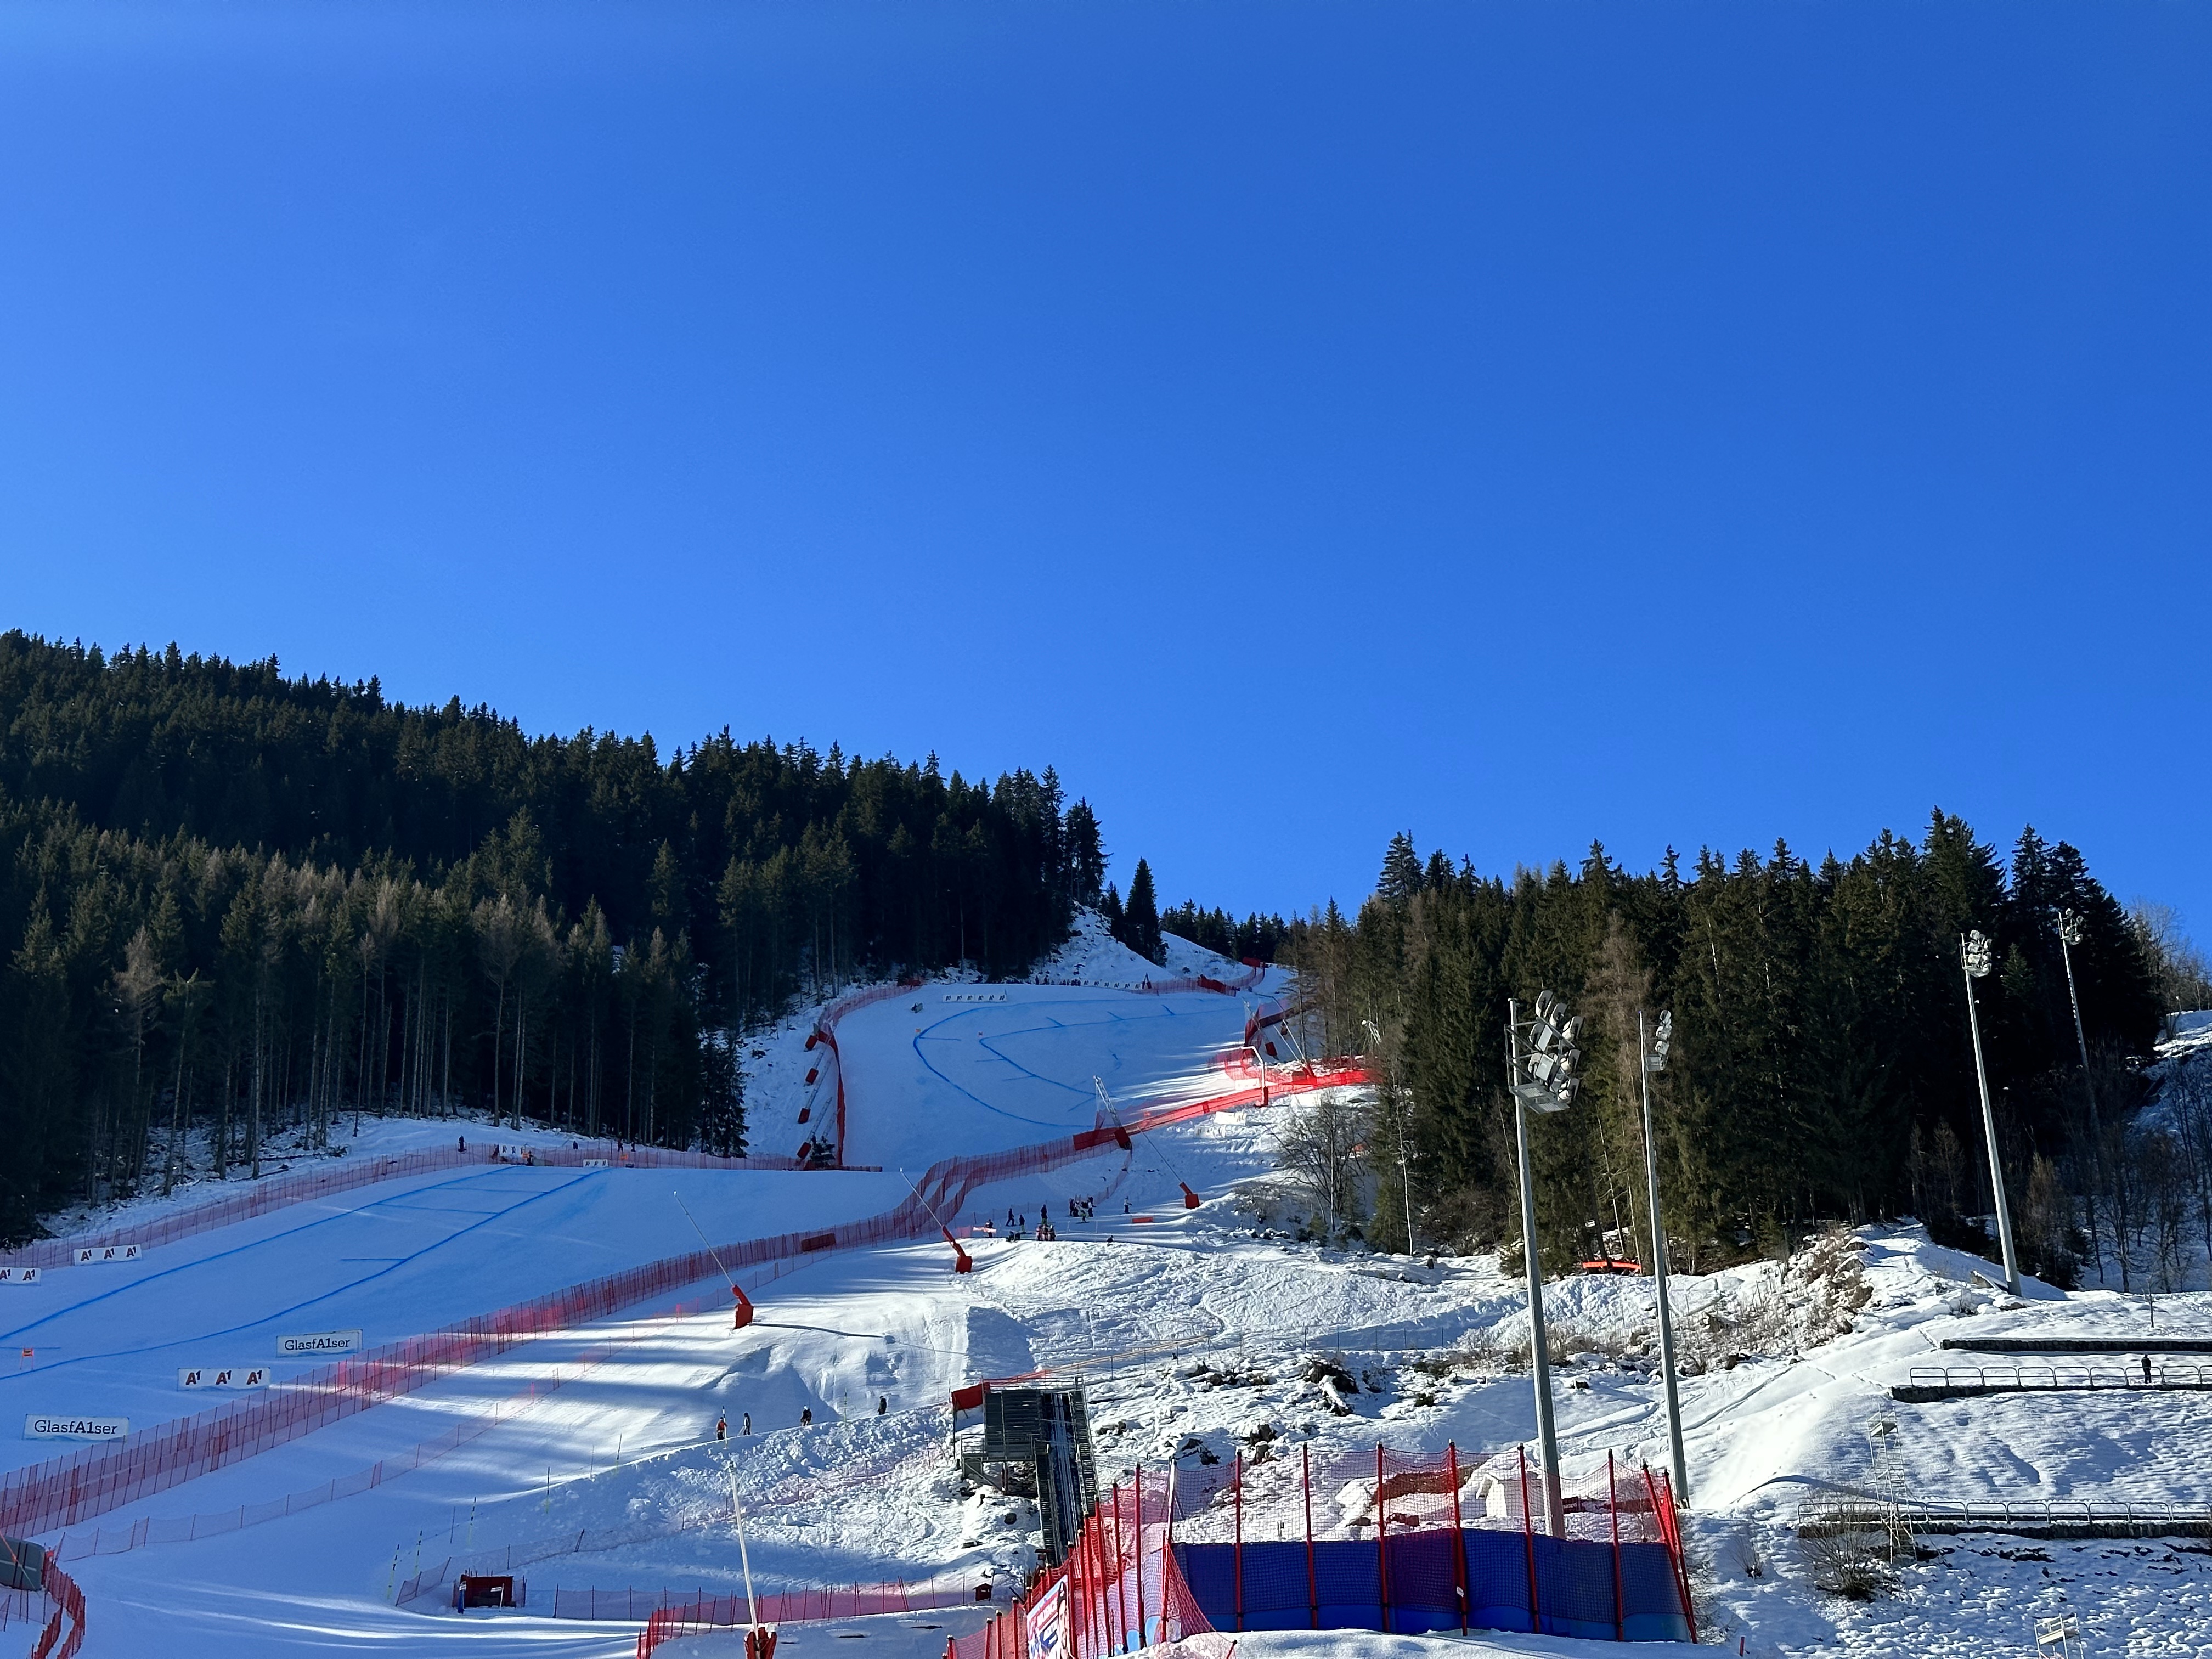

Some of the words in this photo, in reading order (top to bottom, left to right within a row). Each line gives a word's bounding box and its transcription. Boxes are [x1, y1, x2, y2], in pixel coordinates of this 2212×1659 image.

[81, 1250, 92, 1261] A1
[104, 1248, 114, 1260] A1
[126, 1246, 136, 1257] A1
[0, 1269, 10, 1279] A1
[22, 1269, 35, 1281] A1
[284, 1338, 350, 1351] GlasfA1ser
[185, 1370, 201, 1385] A1
[216, 1370, 232, 1385] A1
[246, 1370, 262, 1385] A1
[34, 1420, 117, 1435] GlasfA1ser
